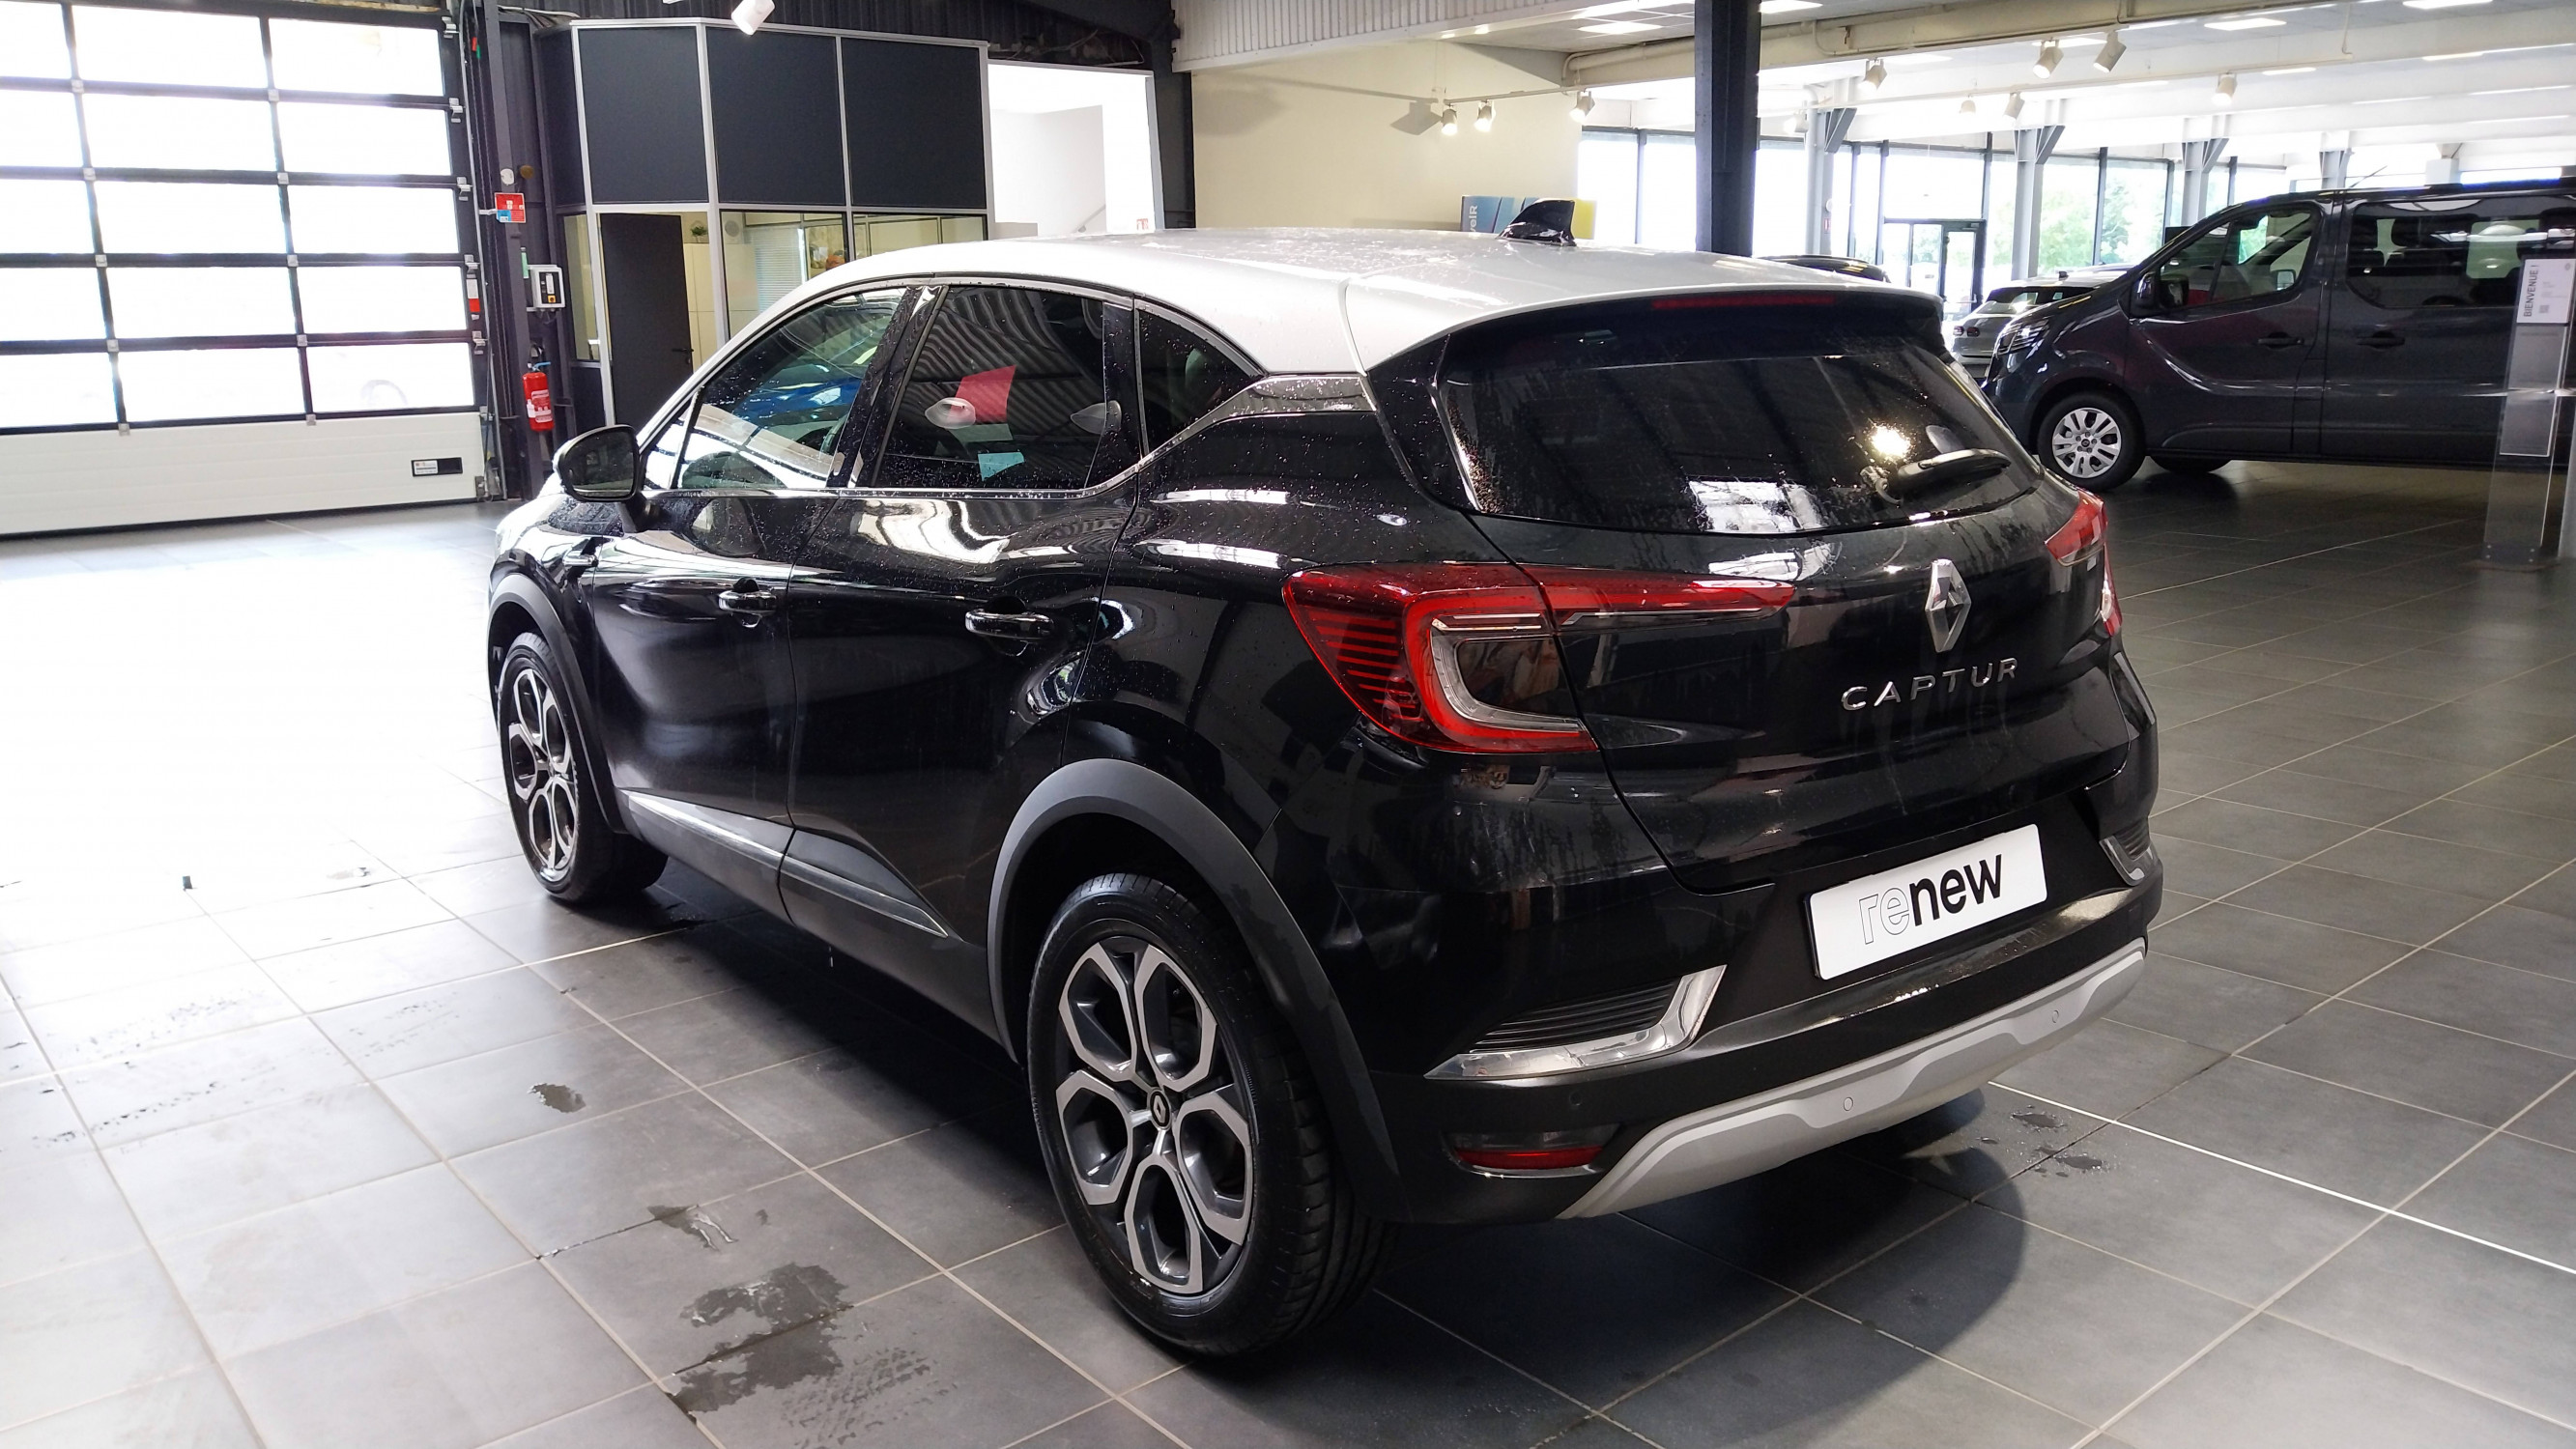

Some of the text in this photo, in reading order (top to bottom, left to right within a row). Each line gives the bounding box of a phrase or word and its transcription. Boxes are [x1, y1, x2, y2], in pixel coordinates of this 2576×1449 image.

[2523, 270, 2538, 317] BIENVENUE
[1841, 657, 2018, 711] CAPTUR
[1858, 854, 2002, 945] renew
